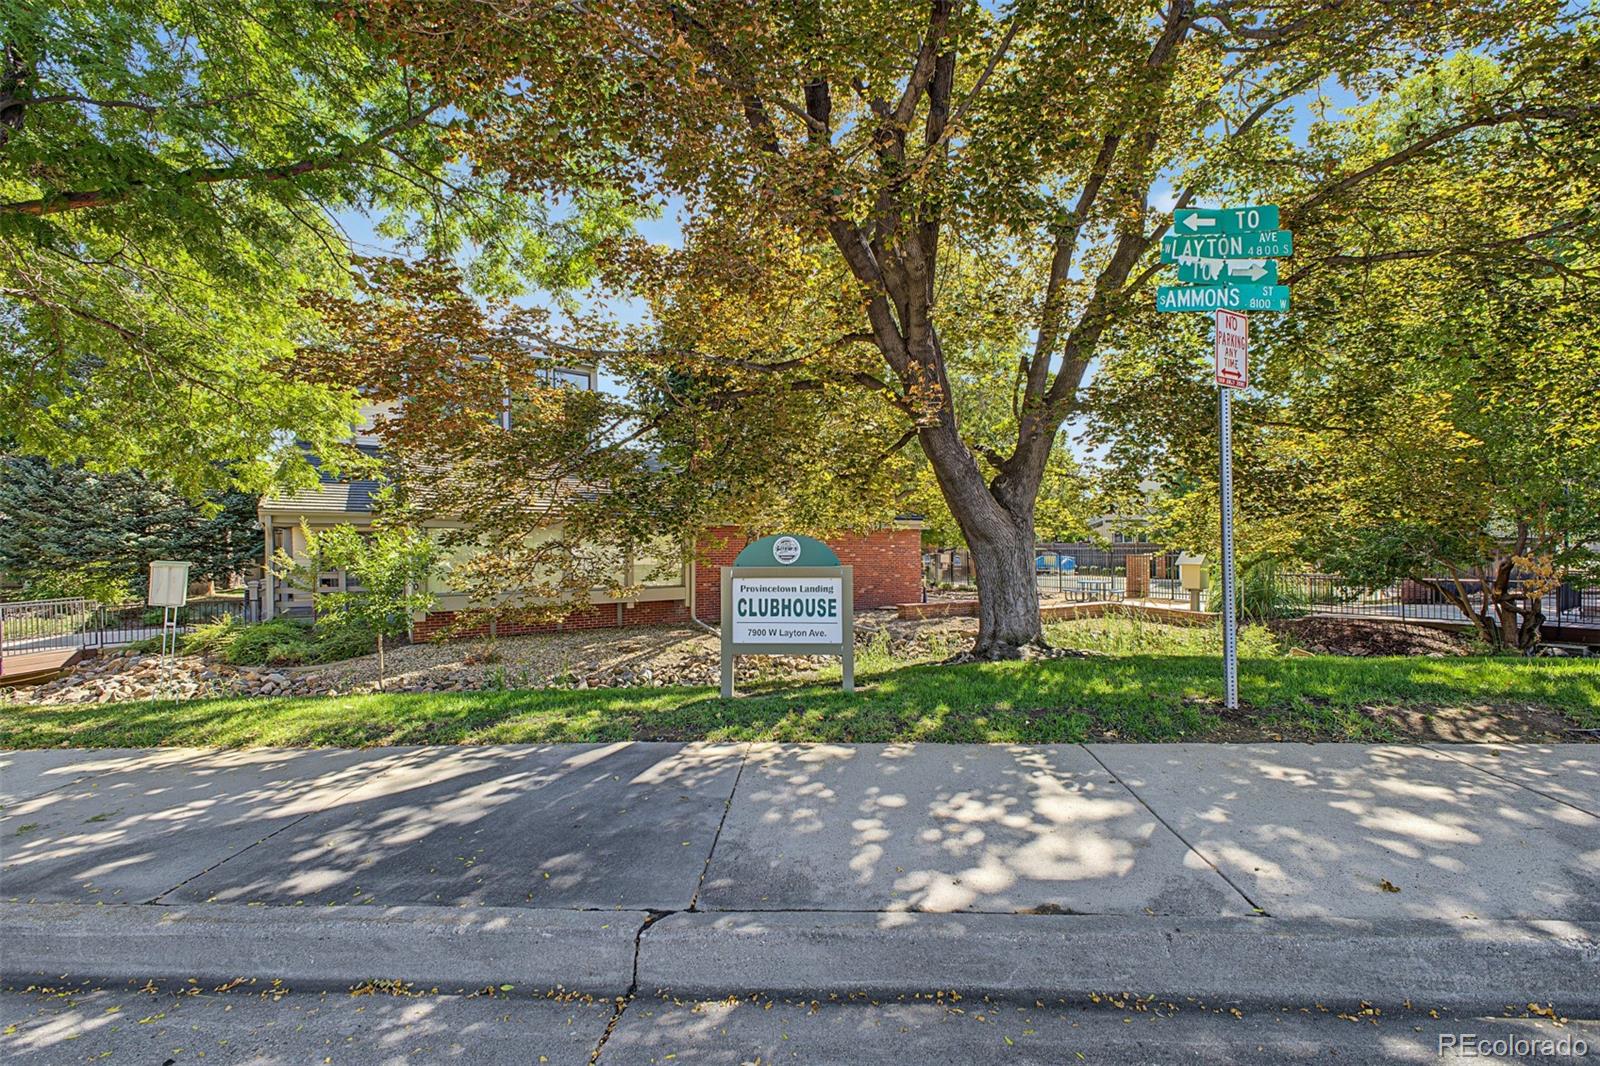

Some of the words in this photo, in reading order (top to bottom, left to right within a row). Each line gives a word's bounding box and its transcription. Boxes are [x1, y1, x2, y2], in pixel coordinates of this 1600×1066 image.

[1235, 210, 1260, 229] TO
[1259, 232, 1278, 243] AVE
[1164, 243, 1171, 254] W
[1171, 236, 1242, 260] LAYTON
[1248, 244, 1279, 255] 4800
[1283, 244, 1289, 254] S
[1192, 261, 1211, 281] TO
[1165, 288, 1240, 308] AMMONS
[1262, 286, 1274, 297] ST
[1250, 299, 1271, 309] 8100
[1280, 299, 1287, 309] W
[1225, 315, 1238, 331] NO
[1218, 331, 1245, 350] PARKING
[1224, 347, 1238, 358] ANY
[1224, 357, 1239, 370] TIME
[740, 584, 797, 593] Provincetown
[799, 584, 834, 594] Landing
[737, 598, 837, 618] CLUBHOUSE
[747, 628, 767, 637] 7900
[768, 628, 777, 637] W
[779, 629, 807, 639] Layton
[808, 629, 827, 638] Ave.
